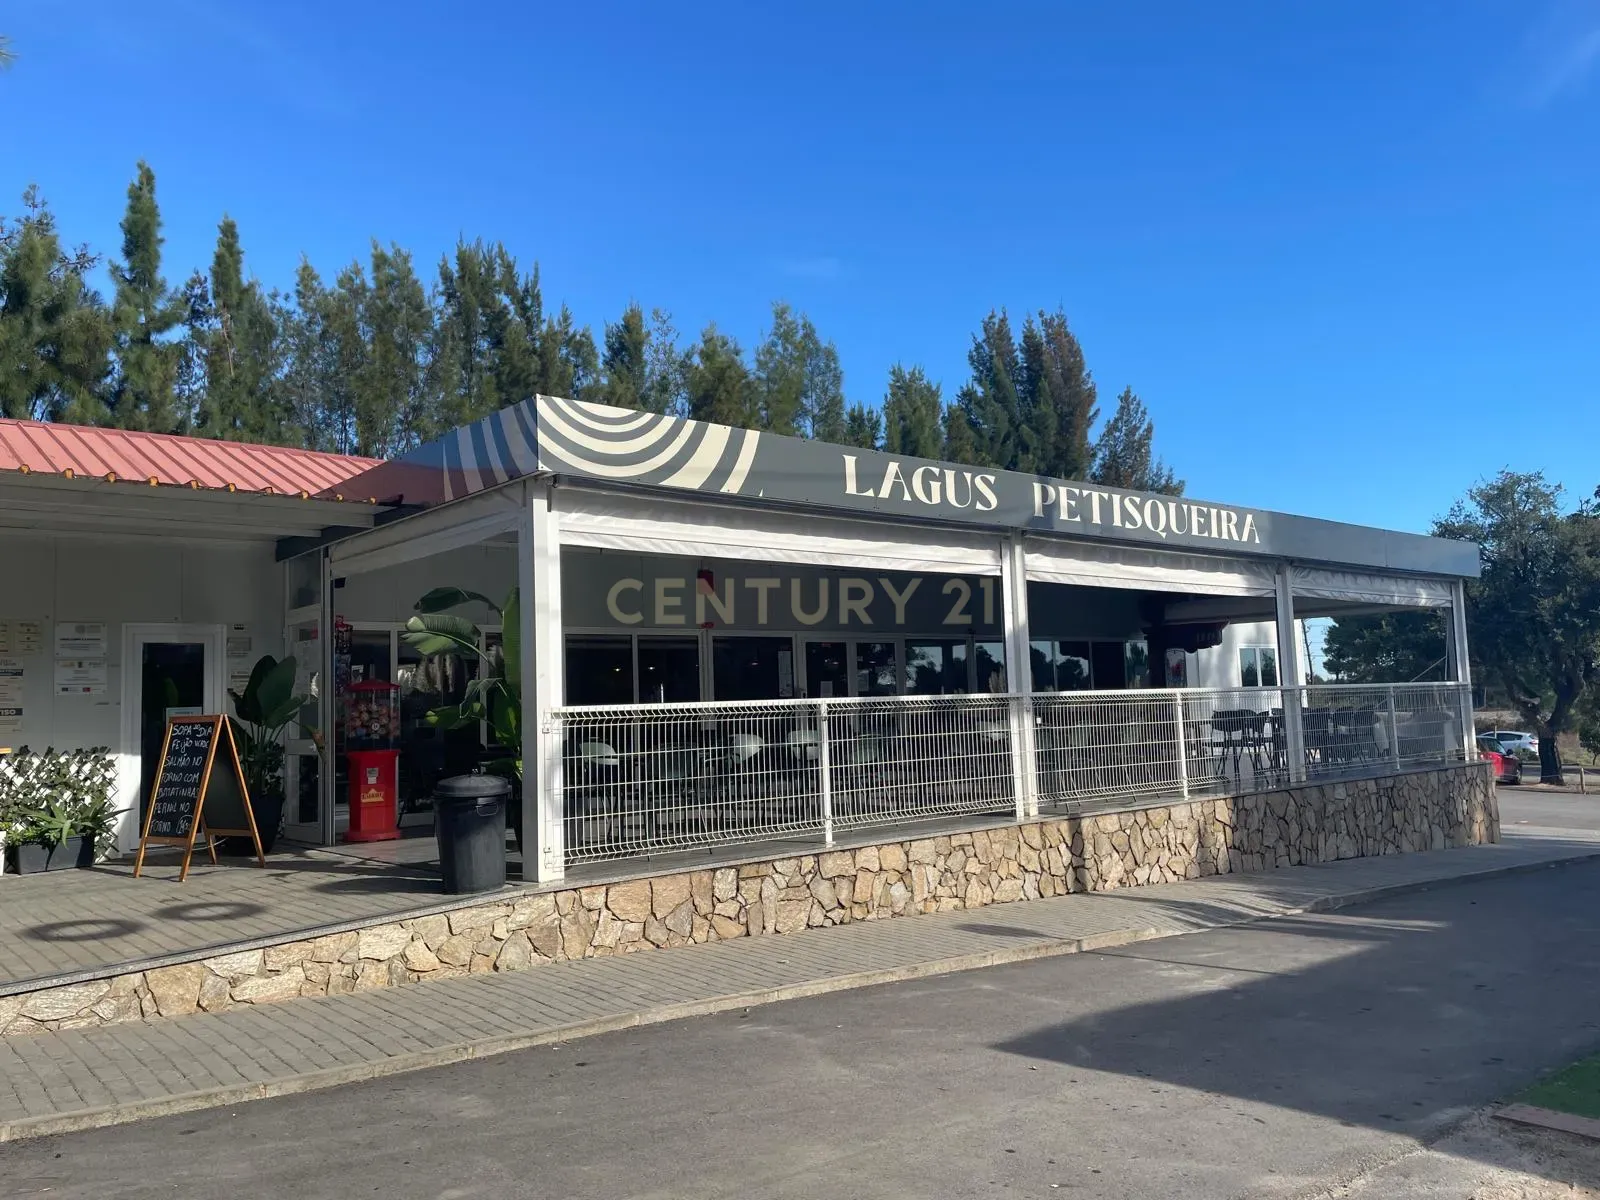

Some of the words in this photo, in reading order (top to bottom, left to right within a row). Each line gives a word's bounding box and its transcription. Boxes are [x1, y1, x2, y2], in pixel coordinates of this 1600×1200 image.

[842, 454, 998, 512] LAGUS
[1032, 481, 1260, 544] PETISQUEIRA
[172, 724, 192, 736] SOPA
[196, 726, 212, 737] DIA
[183, 772, 200, 783] COM
[179, 802, 190, 813] NO
